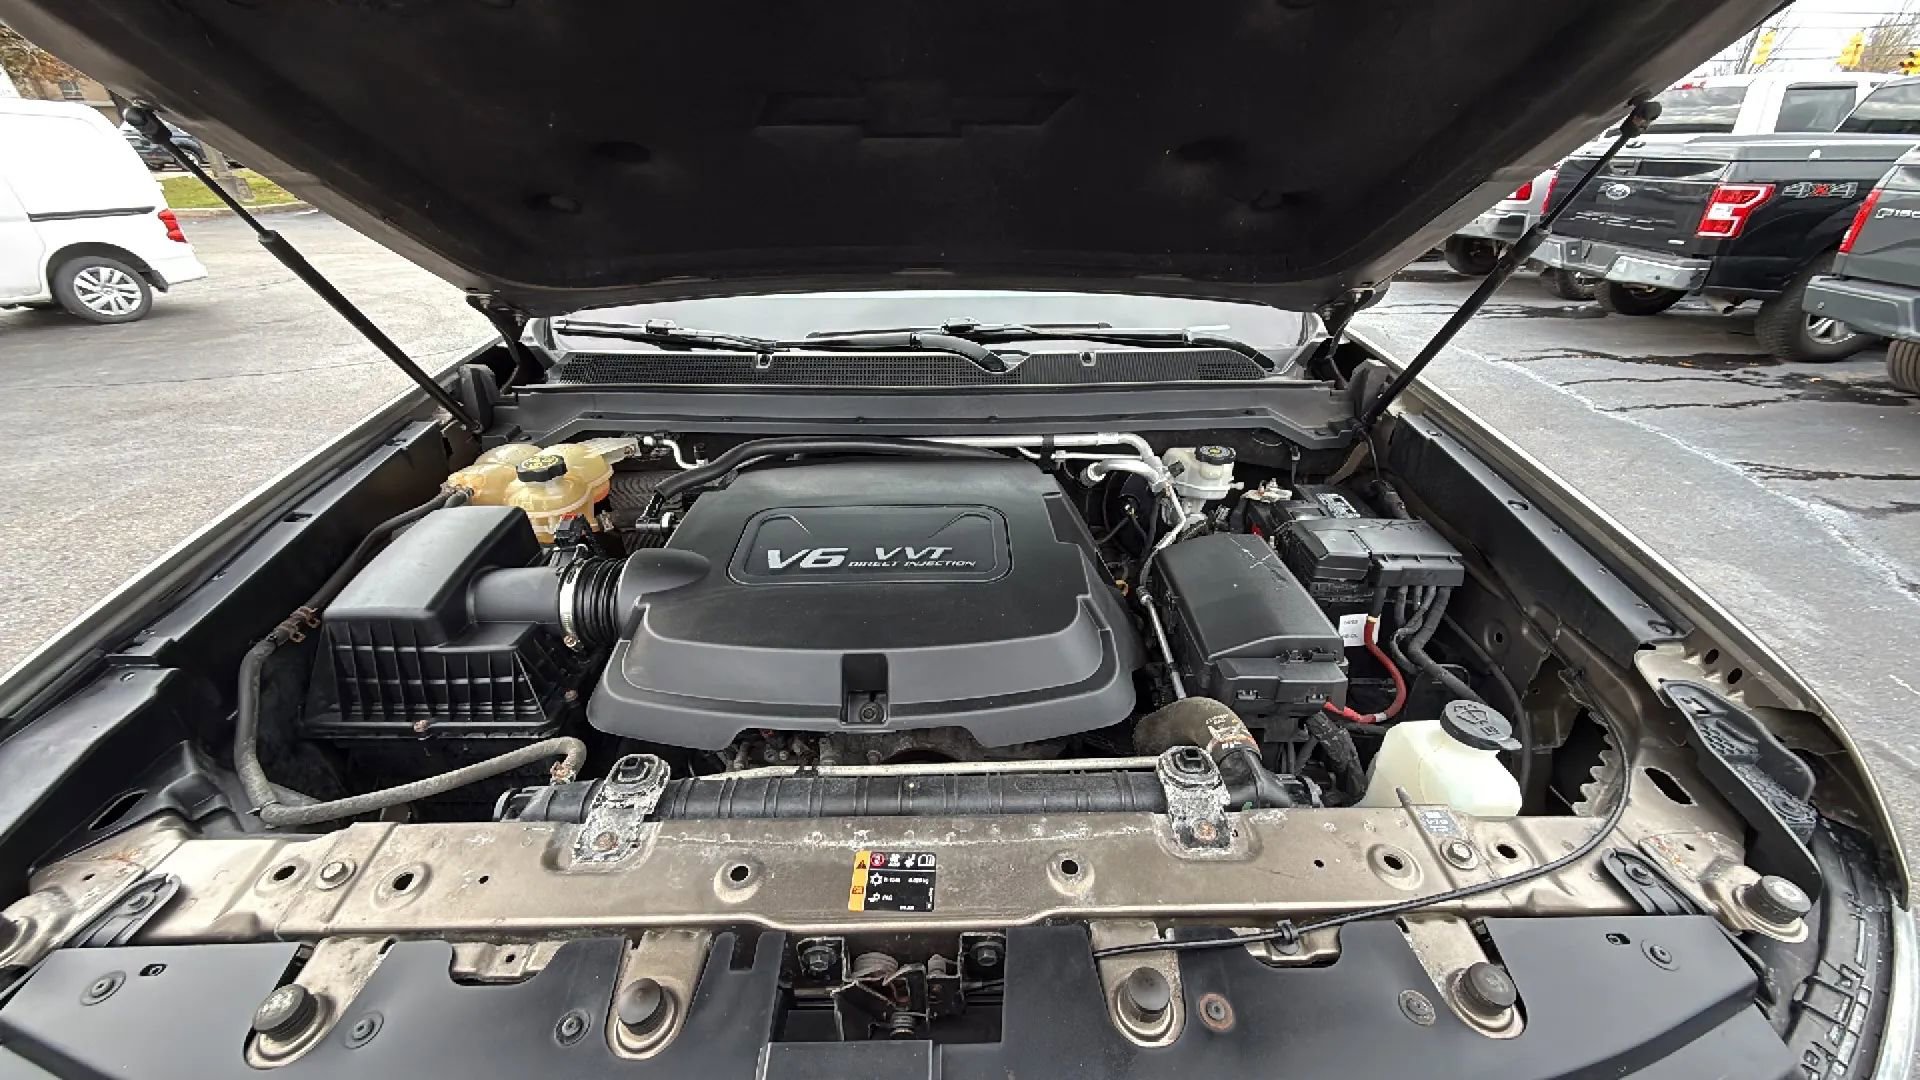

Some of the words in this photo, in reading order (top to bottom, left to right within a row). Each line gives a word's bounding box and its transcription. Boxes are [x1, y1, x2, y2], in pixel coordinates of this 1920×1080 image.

[1781, 182, 1858, 198] 4x4
[767, 547, 848, 569] V6
[875, 546, 952, 561] VVT
[847, 560, 900, 568] DIRECT
[903, 560, 977, 568] INJECTION
